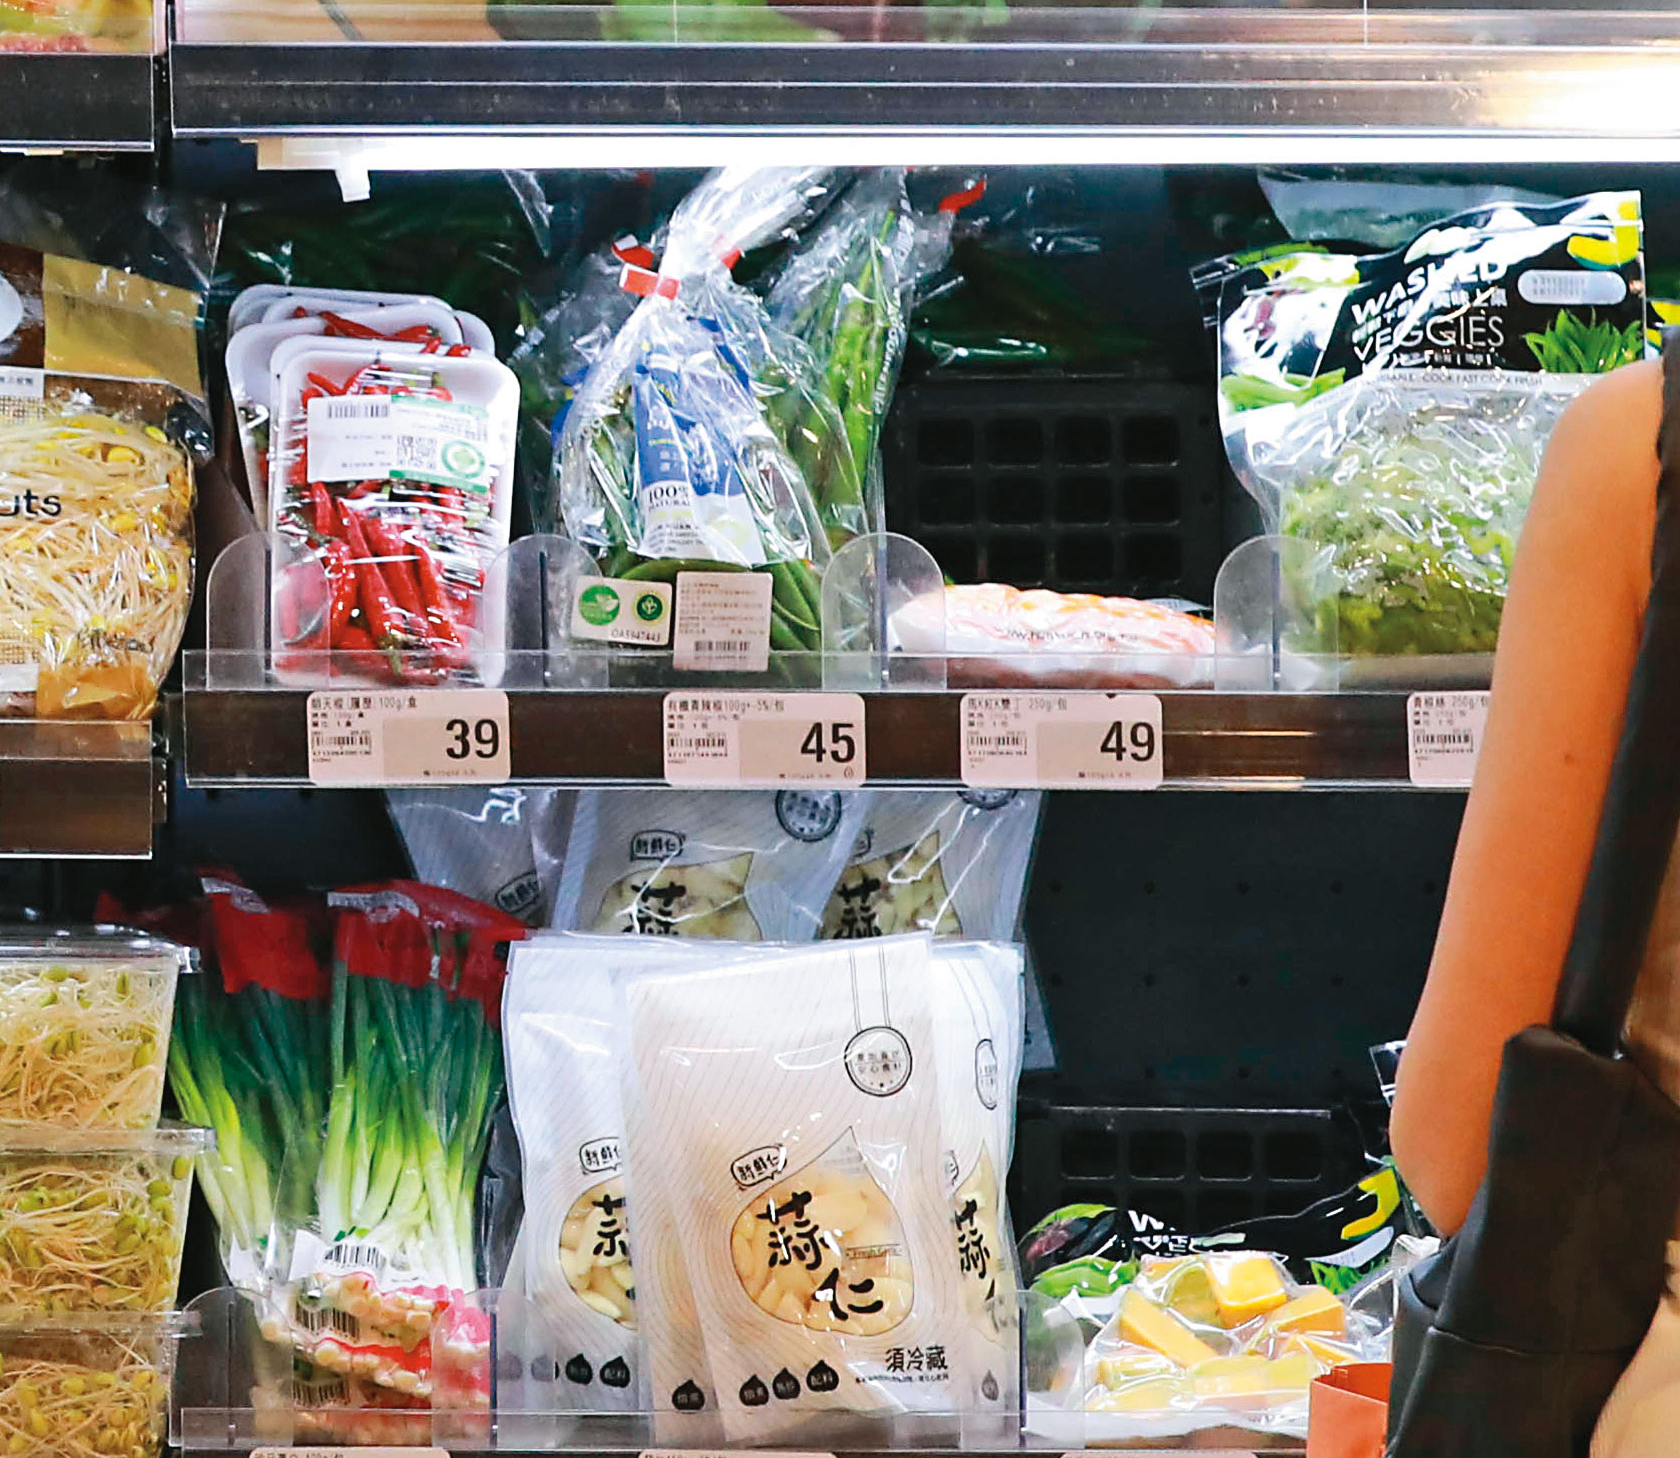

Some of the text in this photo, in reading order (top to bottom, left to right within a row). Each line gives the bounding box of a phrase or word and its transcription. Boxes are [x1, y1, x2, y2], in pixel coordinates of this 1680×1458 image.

[1351, 258, 1508, 325] WASHED
[1353, 315, 1505, 362] VEGGIES
[446, 719, 498, 759] 39
[801, 723, 855, 763] 45
[1101, 721, 1154, 761] 49
[756, 1191, 884, 1321] 蒜仁
[885, 1344, 949, 1373] 須冷藏
